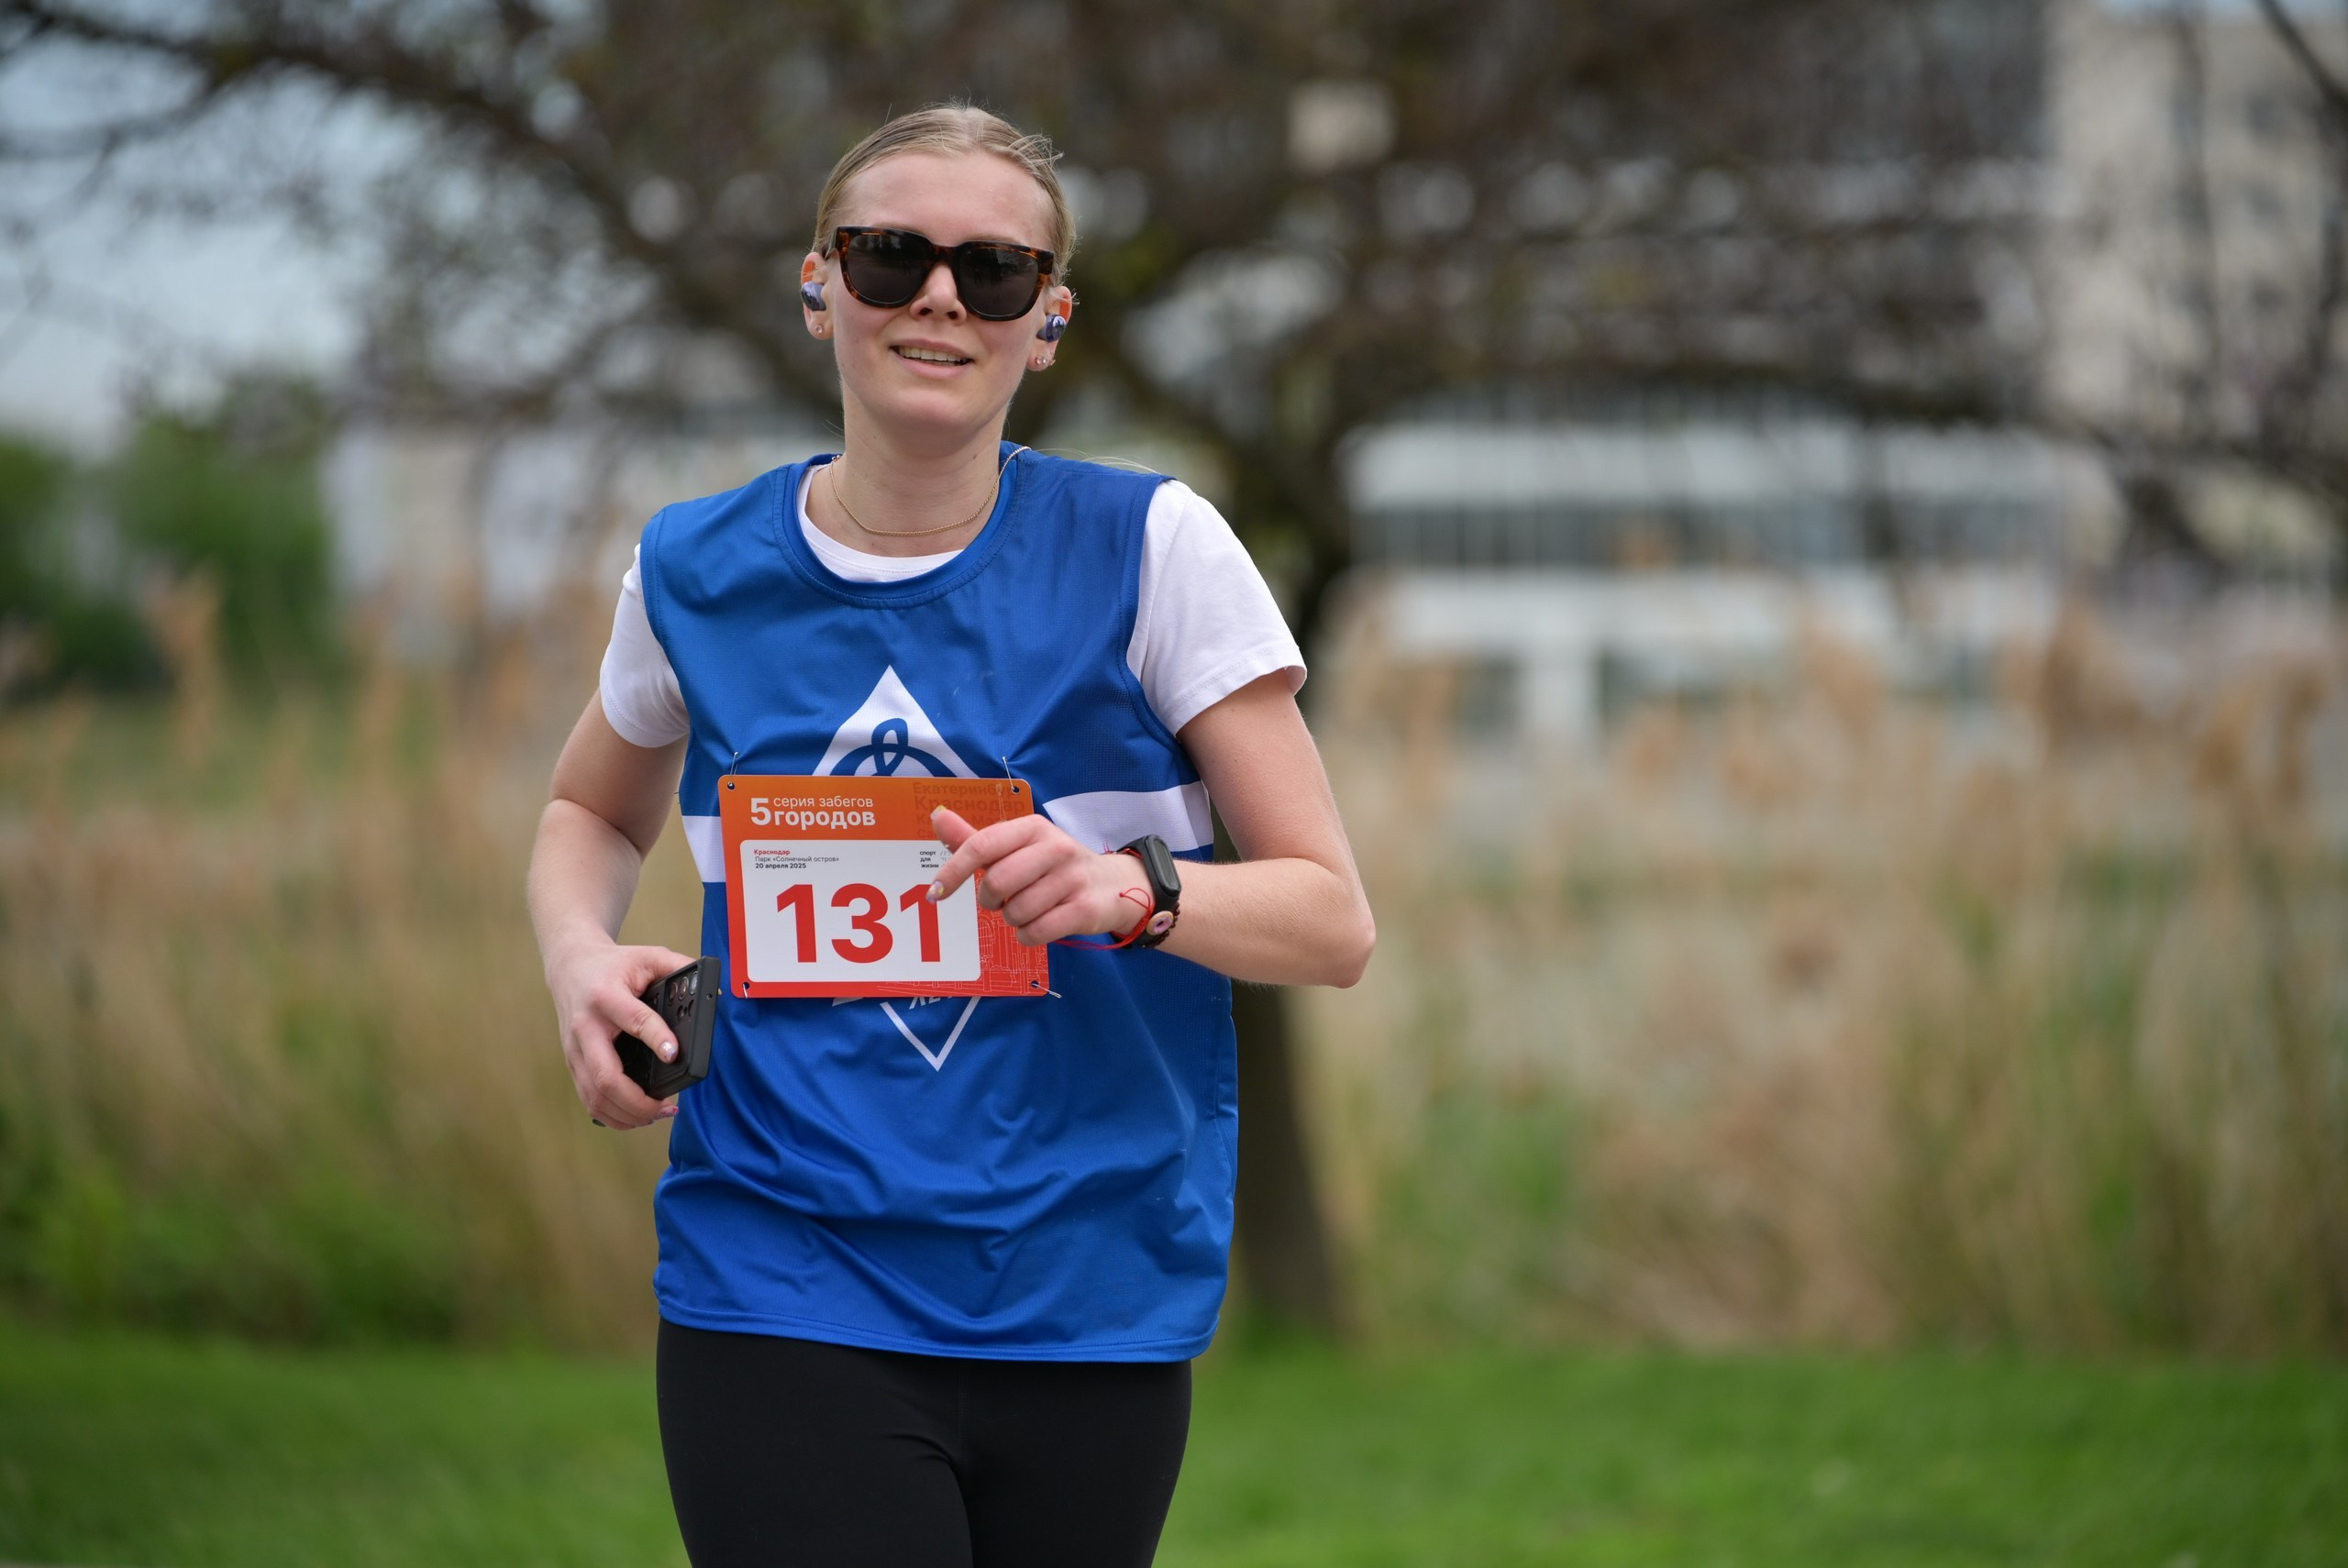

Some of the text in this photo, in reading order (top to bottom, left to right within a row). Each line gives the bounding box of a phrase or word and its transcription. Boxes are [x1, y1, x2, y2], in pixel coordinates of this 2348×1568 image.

[913, 782, 1019, 798] Екатеринбур
[750, 798, 876, 831] 5 городов
[773, 796, 874, 809] серия забегов
[776, 882, 941, 964] 131
